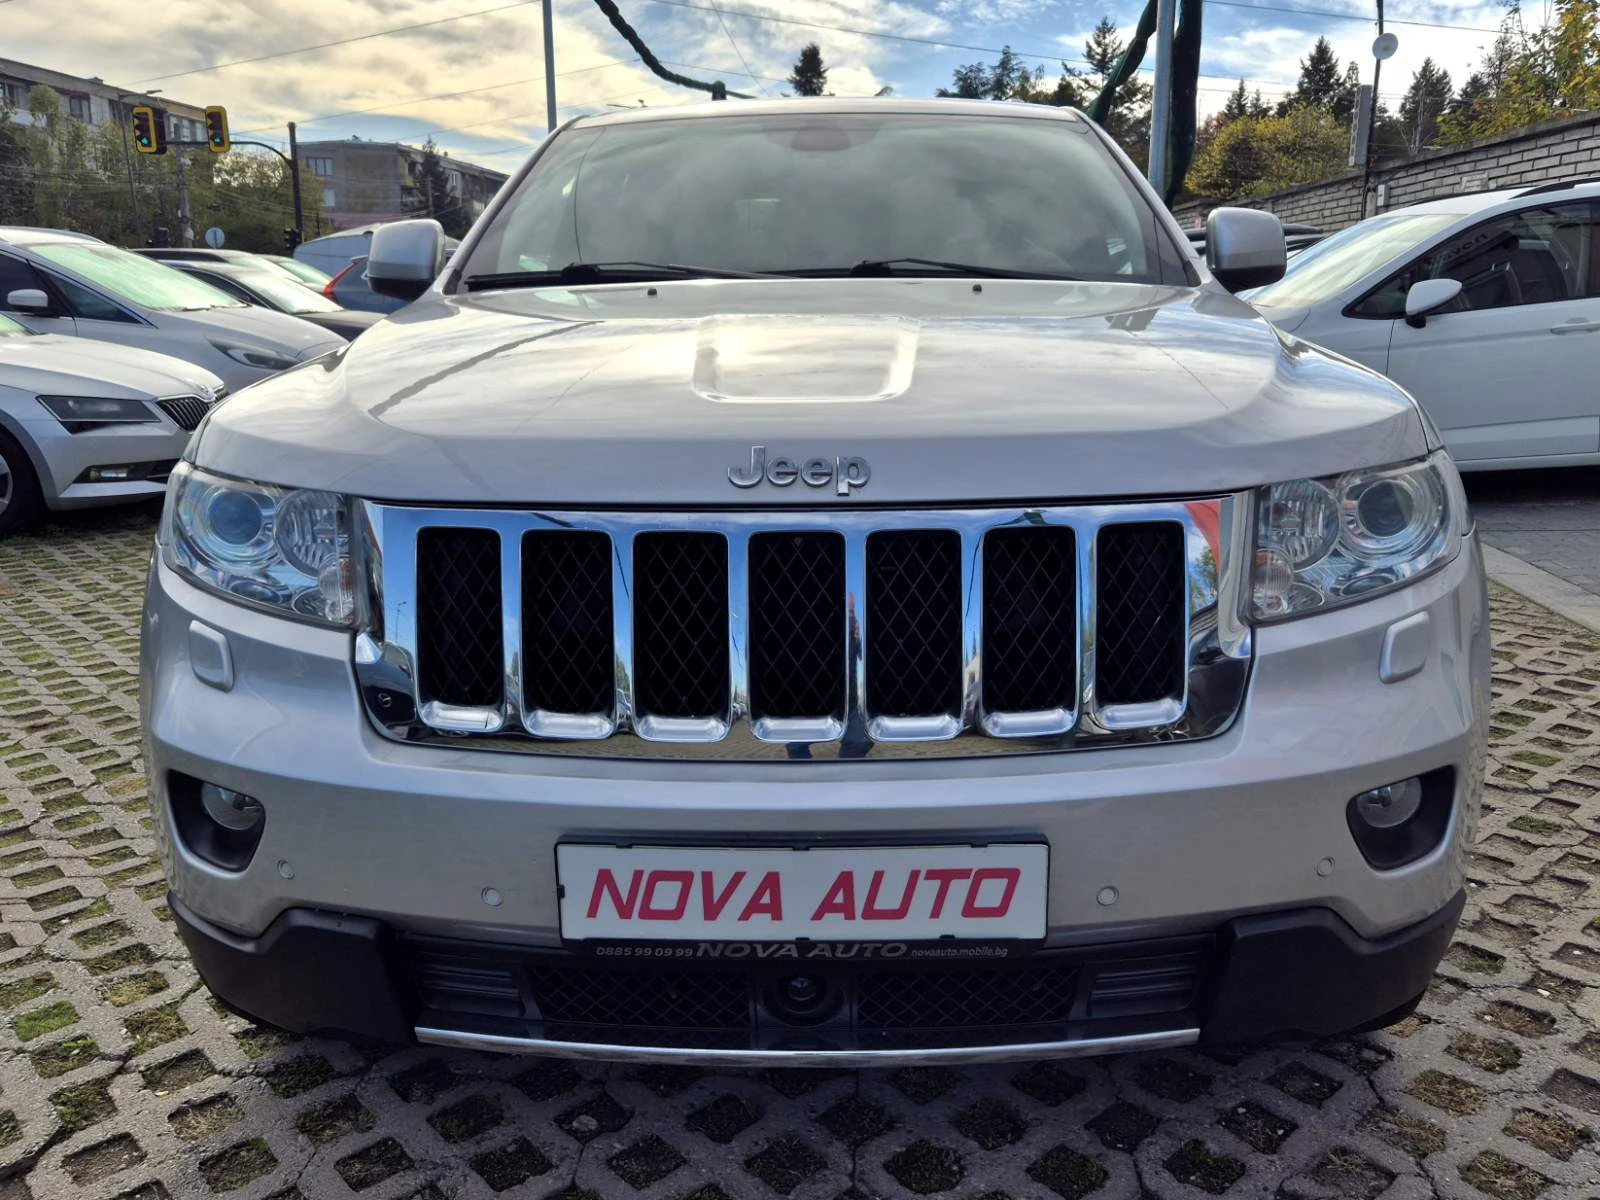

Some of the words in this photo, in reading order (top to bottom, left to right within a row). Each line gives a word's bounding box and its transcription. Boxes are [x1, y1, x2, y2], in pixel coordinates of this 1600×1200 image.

[727, 445, 871, 496] Jeep
[586, 868, 784, 922] NOVA
[809, 867, 1022, 921] AUTO
[595, 946, 633, 956] 0885
[634, 946, 653, 957] 99
[654, 947, 673, 957] 09
[675, 947, 694, 957] 99
[696, 942, 799, 958] NOVA
[806, 942, 908, 958] AUTO
